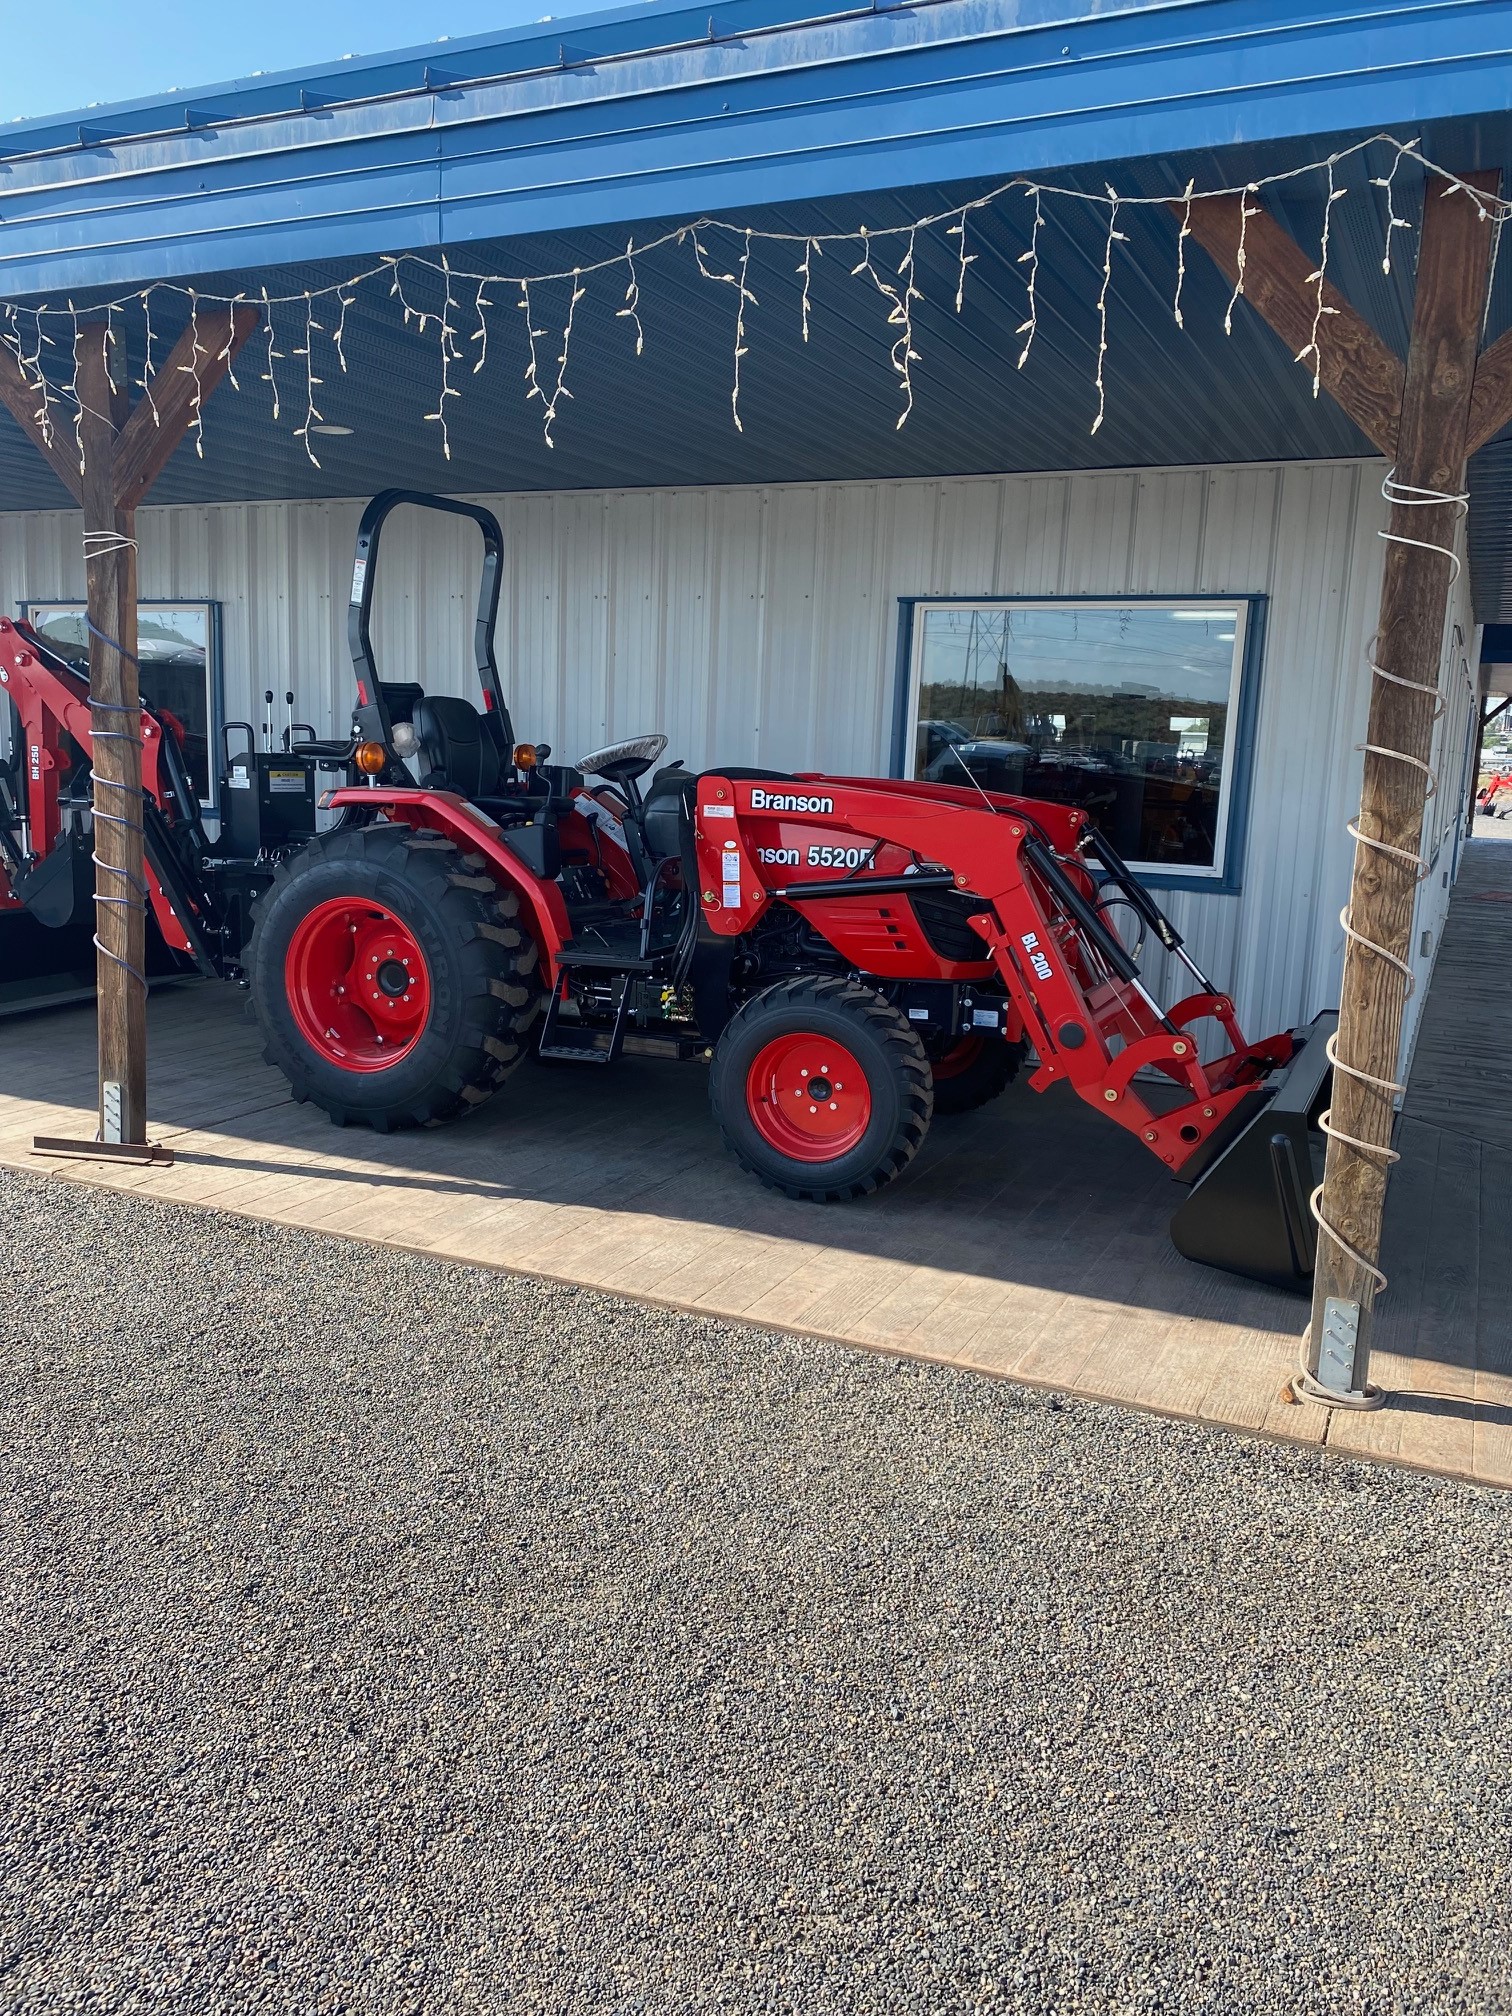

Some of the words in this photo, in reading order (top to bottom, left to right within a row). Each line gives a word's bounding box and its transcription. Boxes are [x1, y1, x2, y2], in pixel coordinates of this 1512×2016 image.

[31, 745, 39, 765] 250
[31, 766, 40, 780] BH
[751, 789, 833, 813] Branson
[757, 847, 800, 865] nson
[1021, 932, 1040, 953] BL
[1030, 952, 1053, 980] 200
